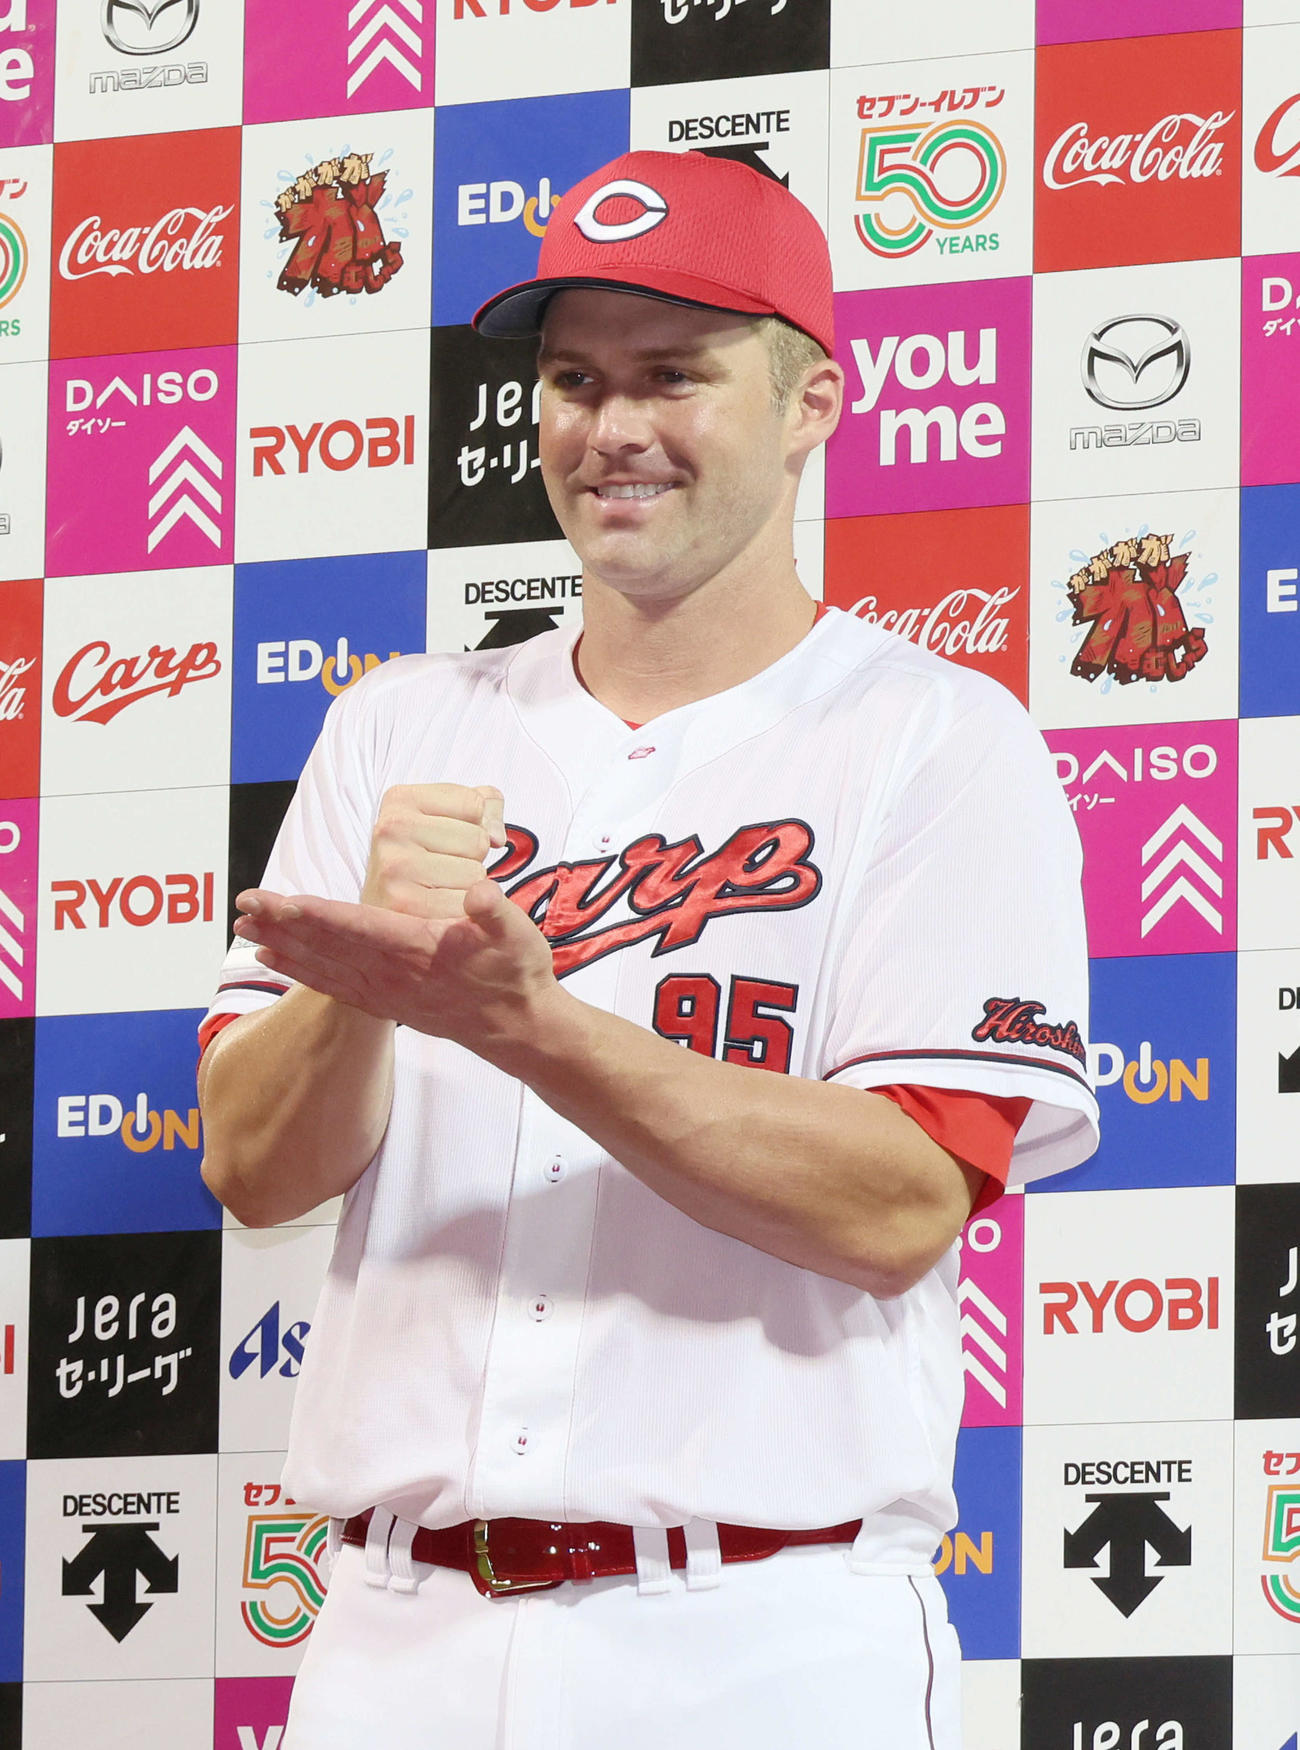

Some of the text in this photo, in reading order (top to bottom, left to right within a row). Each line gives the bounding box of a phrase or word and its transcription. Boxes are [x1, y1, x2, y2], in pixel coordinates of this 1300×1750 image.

[668, 109, 790, 142] DESCENTE
[1043, 110, 1236, 190] Coca-Cola
[854, 119, 1007, 259] 50
[59, 204, 235, 280] Coca-Cola
[936, 233, 1000, 255] YEARS
[66, 369, 219, 412] DAISO
[850, 328, 997, 414] you
[66, 417, 127, 436] ダイソー
[250, 415, 415, 477] RYOBI
[879, 402, 1006, 466] me
[464, 575, 582, 605] DESCENTE
[52, 641, 221, 725] Carp
[1050, 744, 1217, 787] DAISO
[1063, 793, 1115, 812] イソー
[52, 872, 214, 930] RYOBI
[652, 973, 799, 1075] 95
[1089, 1041, 1209, 1104] DION
[57, 1092, 199, 1153] EDION
[1039, 1276, 1219, 1335] RYOBI
[1064, 1459, 1192, 1486] DESCENTE
[62, 1491, 180, 1517] DESCENTE
